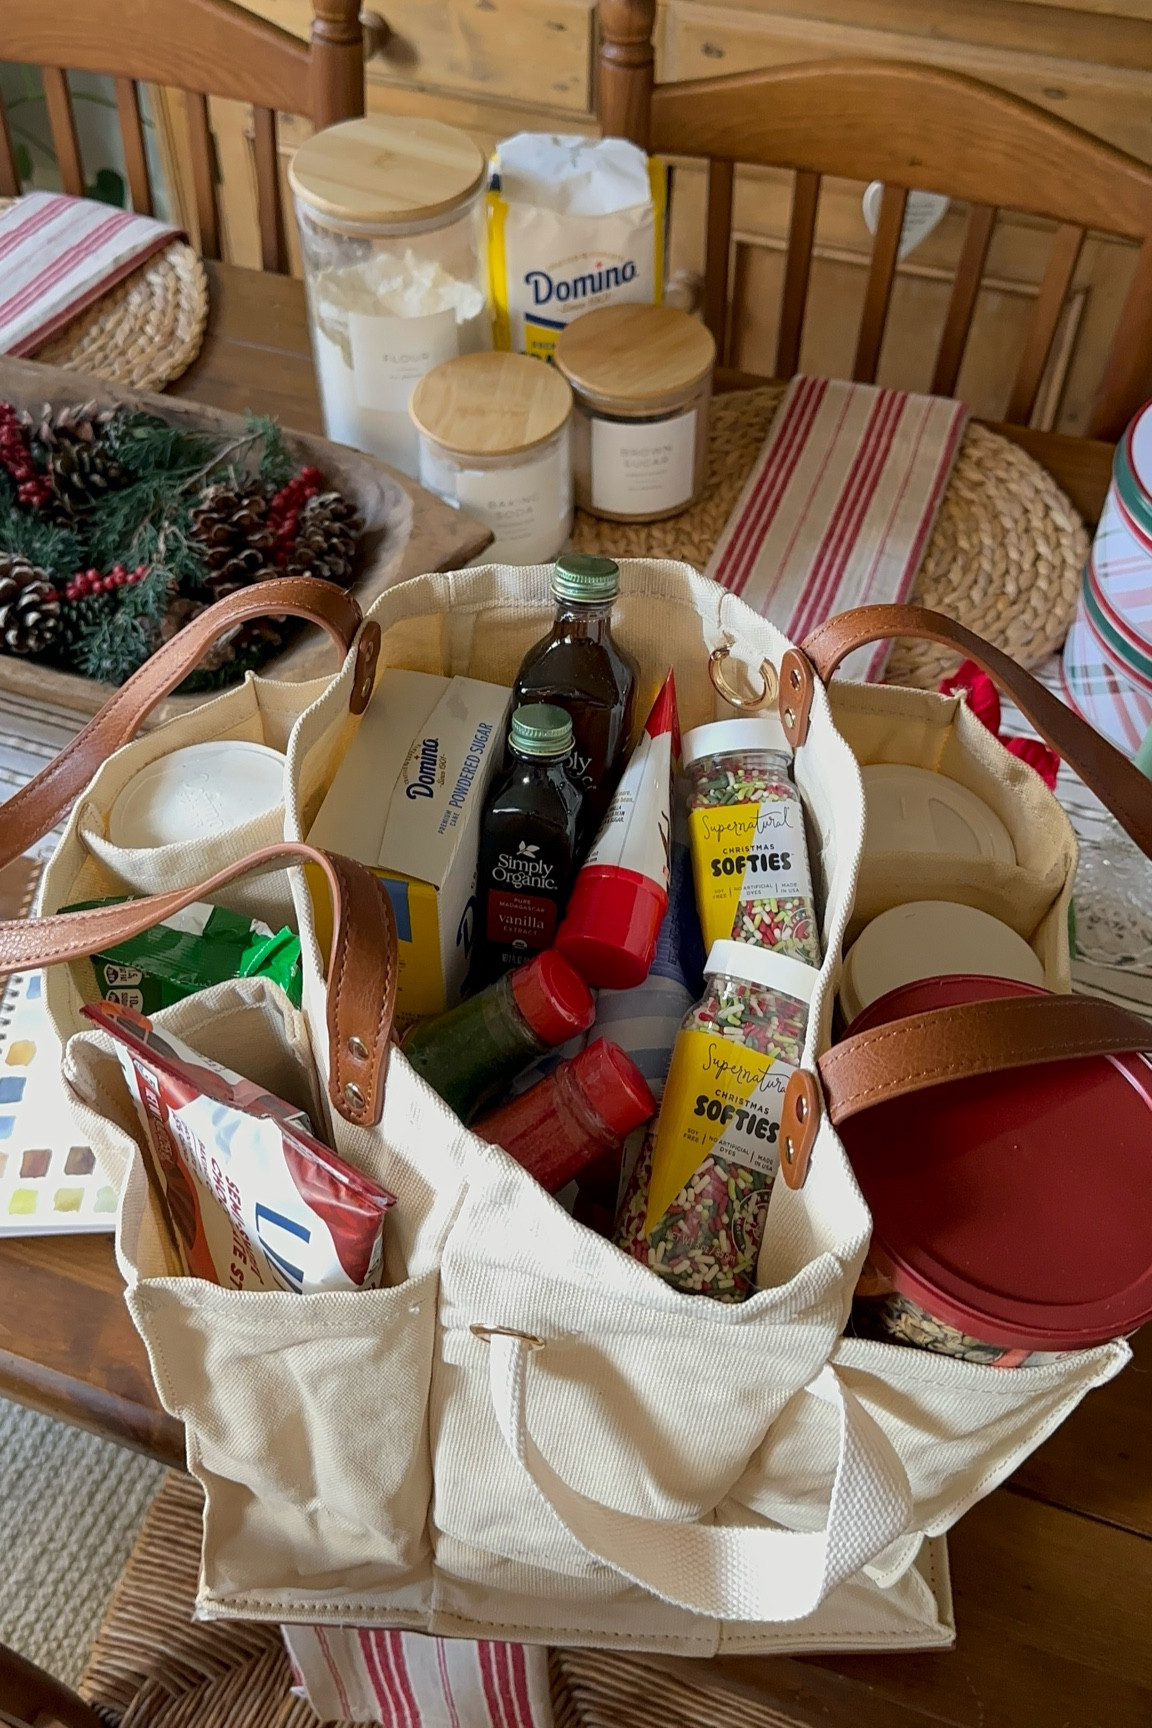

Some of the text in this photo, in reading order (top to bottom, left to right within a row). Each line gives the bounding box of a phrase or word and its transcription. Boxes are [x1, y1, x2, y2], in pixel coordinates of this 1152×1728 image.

[524, 260, 636, 305] Domino
[406, 739, 438, 800] Domino
[448, 722, 493, 809] POWDERED SUGAR
[438, 809, 453, 835] PREMIUM
[450, 812, 460, 827] CANE
[702, 806, 794, 842] Supernatural
[722, 843, 775, 855] CHRISTMAS
[498, 853, 554, 878] Simply
[711, 852, 792, 877] SOFTIES
[743, 883, 773, 891] ARTIFICIAL
[498, 901, 546, 913] MADAGASCAR
[513, 896, 532, 906] PURE
[498, 913, 546, 930] vanilla
[503, 925, 538, 936] EXTRACT
[702, 1043, 791, 1094] Supernatura
[715, 1088, 770, 1115] CHRISTMAS
[694, 1094, 780, 1144] SOFTIES
[683, 1133, 699, 1143] FREE
[687, 1127, 699, 1136] SOY
[708, 1135, 750, 1155] NO ARTIFICIAL
[719, 1146, 736, 1157] DYES
[754, 1160, 773, 1171] IN USA
[757, 1154, 774, 1165] MADE
